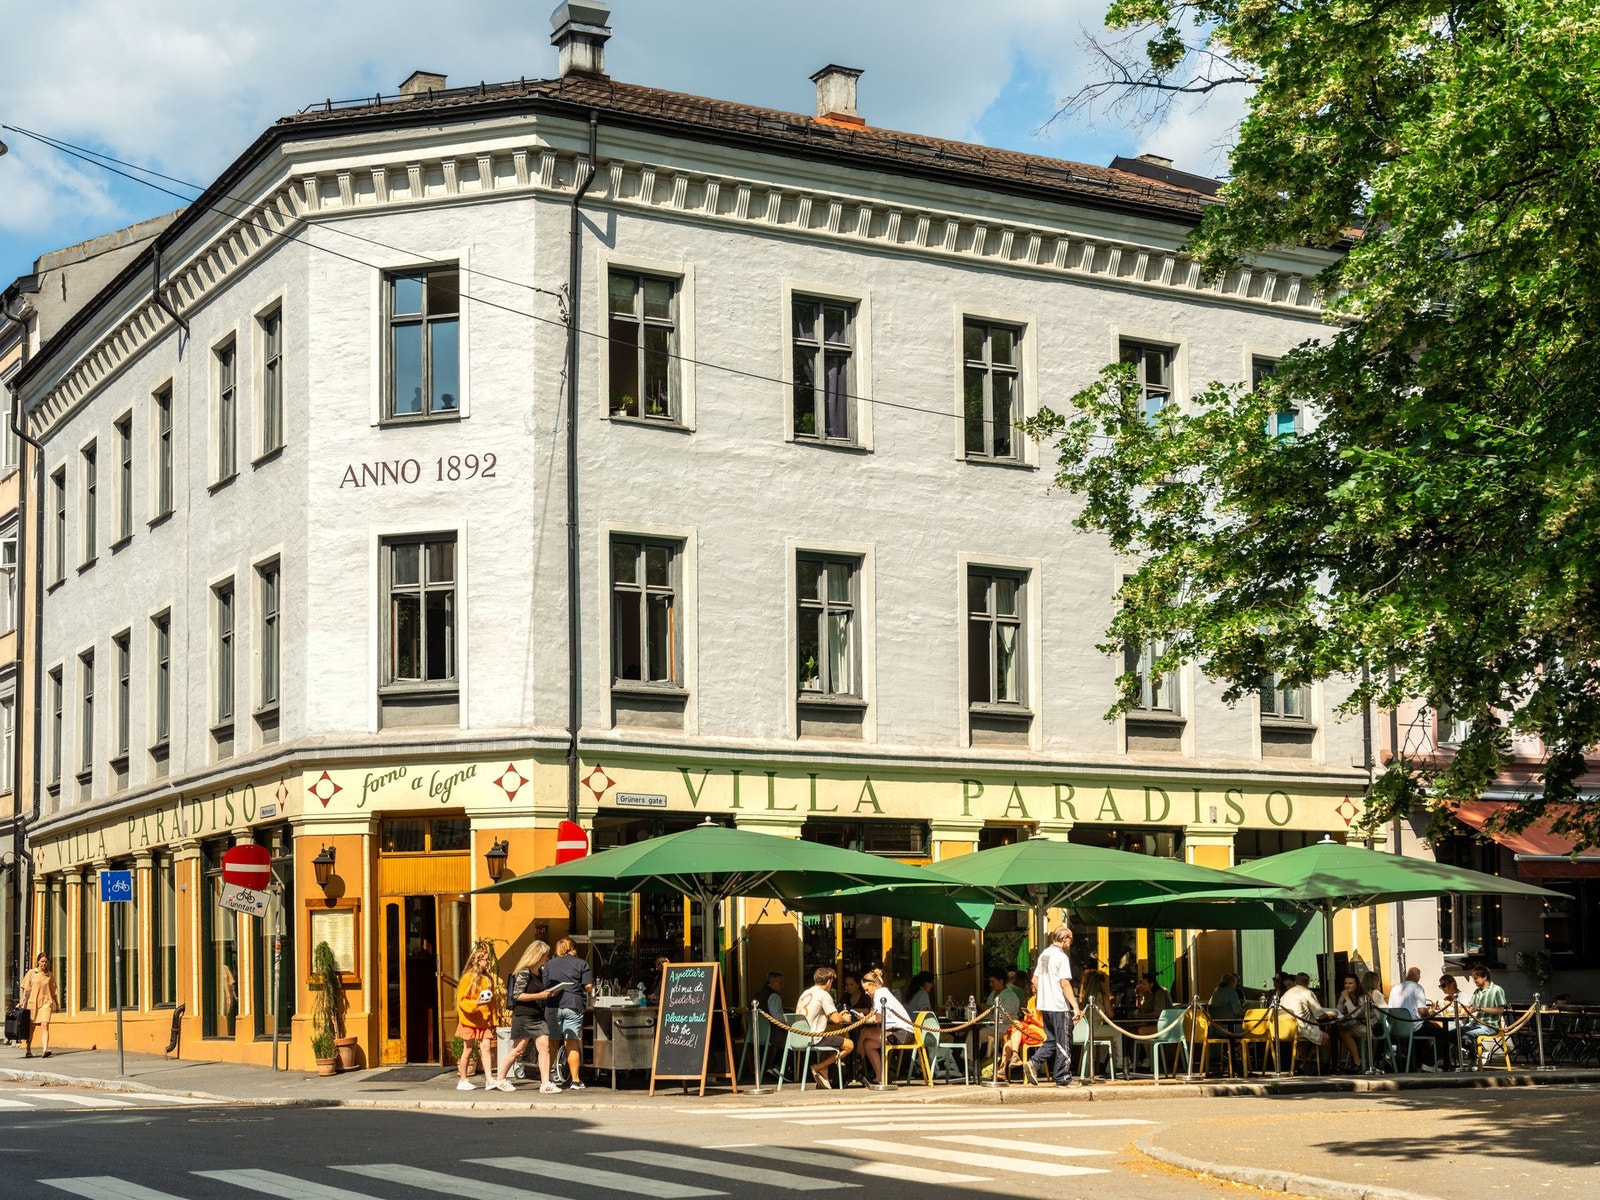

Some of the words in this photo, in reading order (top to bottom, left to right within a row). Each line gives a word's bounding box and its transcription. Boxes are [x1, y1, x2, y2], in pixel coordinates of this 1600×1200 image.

[339, 458, 421, 489] ANNO
[436, 452, 497, 482] 1892
[357, 765, 407, 808] forno
[411, 776, 423, 790] a
[429, 764, 477, 804] legna
[676, 767, 885, 814] VILLA
[959, 778, 1293, 826] PARADISO
[620, 795, 646, 804] Grüners
[648, 797, 663, 805] gate
[55, 825, 108, 866] VILLA
[128, 783, 257, 850] PARADISO
[694, 982, 704, 992] di
[670, 1023, 680, 1033] to
[680, 1023, 691, 1035] be
[689, 1012, 706, 1022] wait
